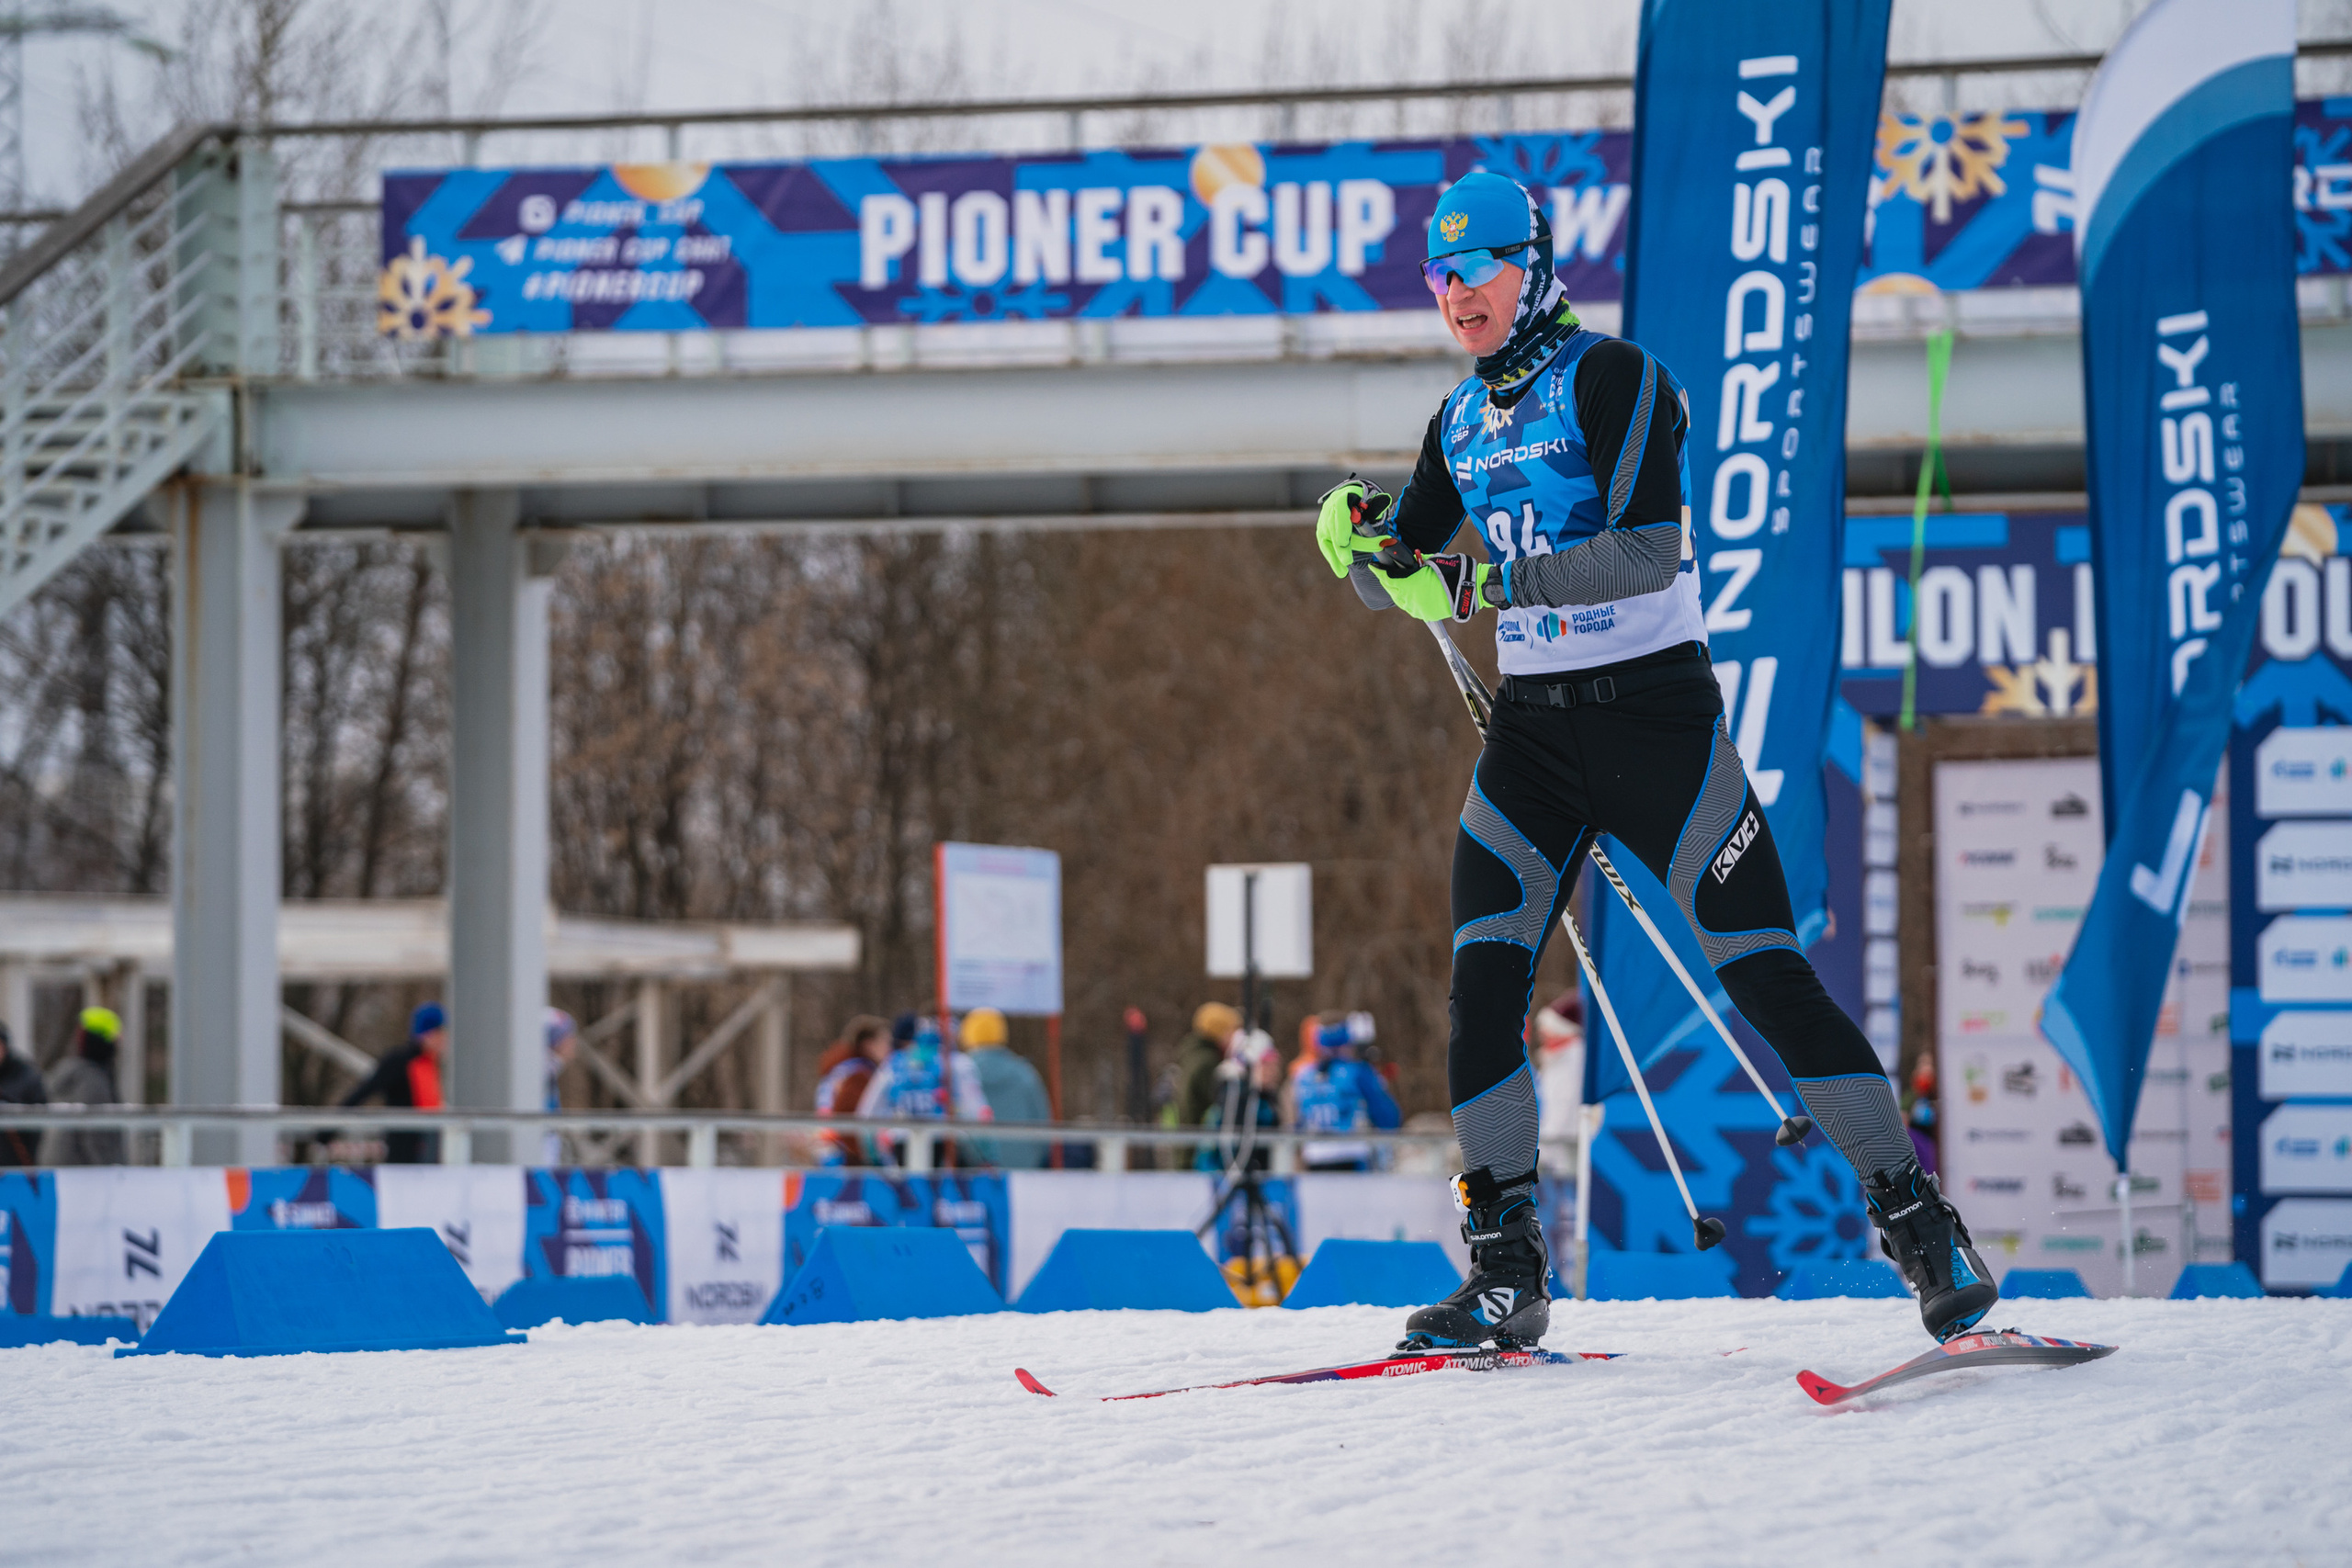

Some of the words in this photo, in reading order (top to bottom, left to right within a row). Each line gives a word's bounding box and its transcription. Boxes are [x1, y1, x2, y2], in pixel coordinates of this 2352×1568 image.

[859, 184, 1186, 290] PIONER
[1208, 176, 1396, 280] CUP
[1704, 53, 1799, 634] NORDSKI
[1771, 145, 1823, 536] SPORTSWEAR
[1475, 437, 1568, 473] NORDSKI
[1487, 502, 1553, 570] 94
[1572, 604, 1616, 624] РОДНЫЕ
[1574, 618, 1615, 635] ГОРОДА
[1981, 1335, 2007, 1347] ATOMIC
[1381, 1361, 1427, 1377] ATOMIC
[1442, 1357, 1494, 1370] ATOMIC
